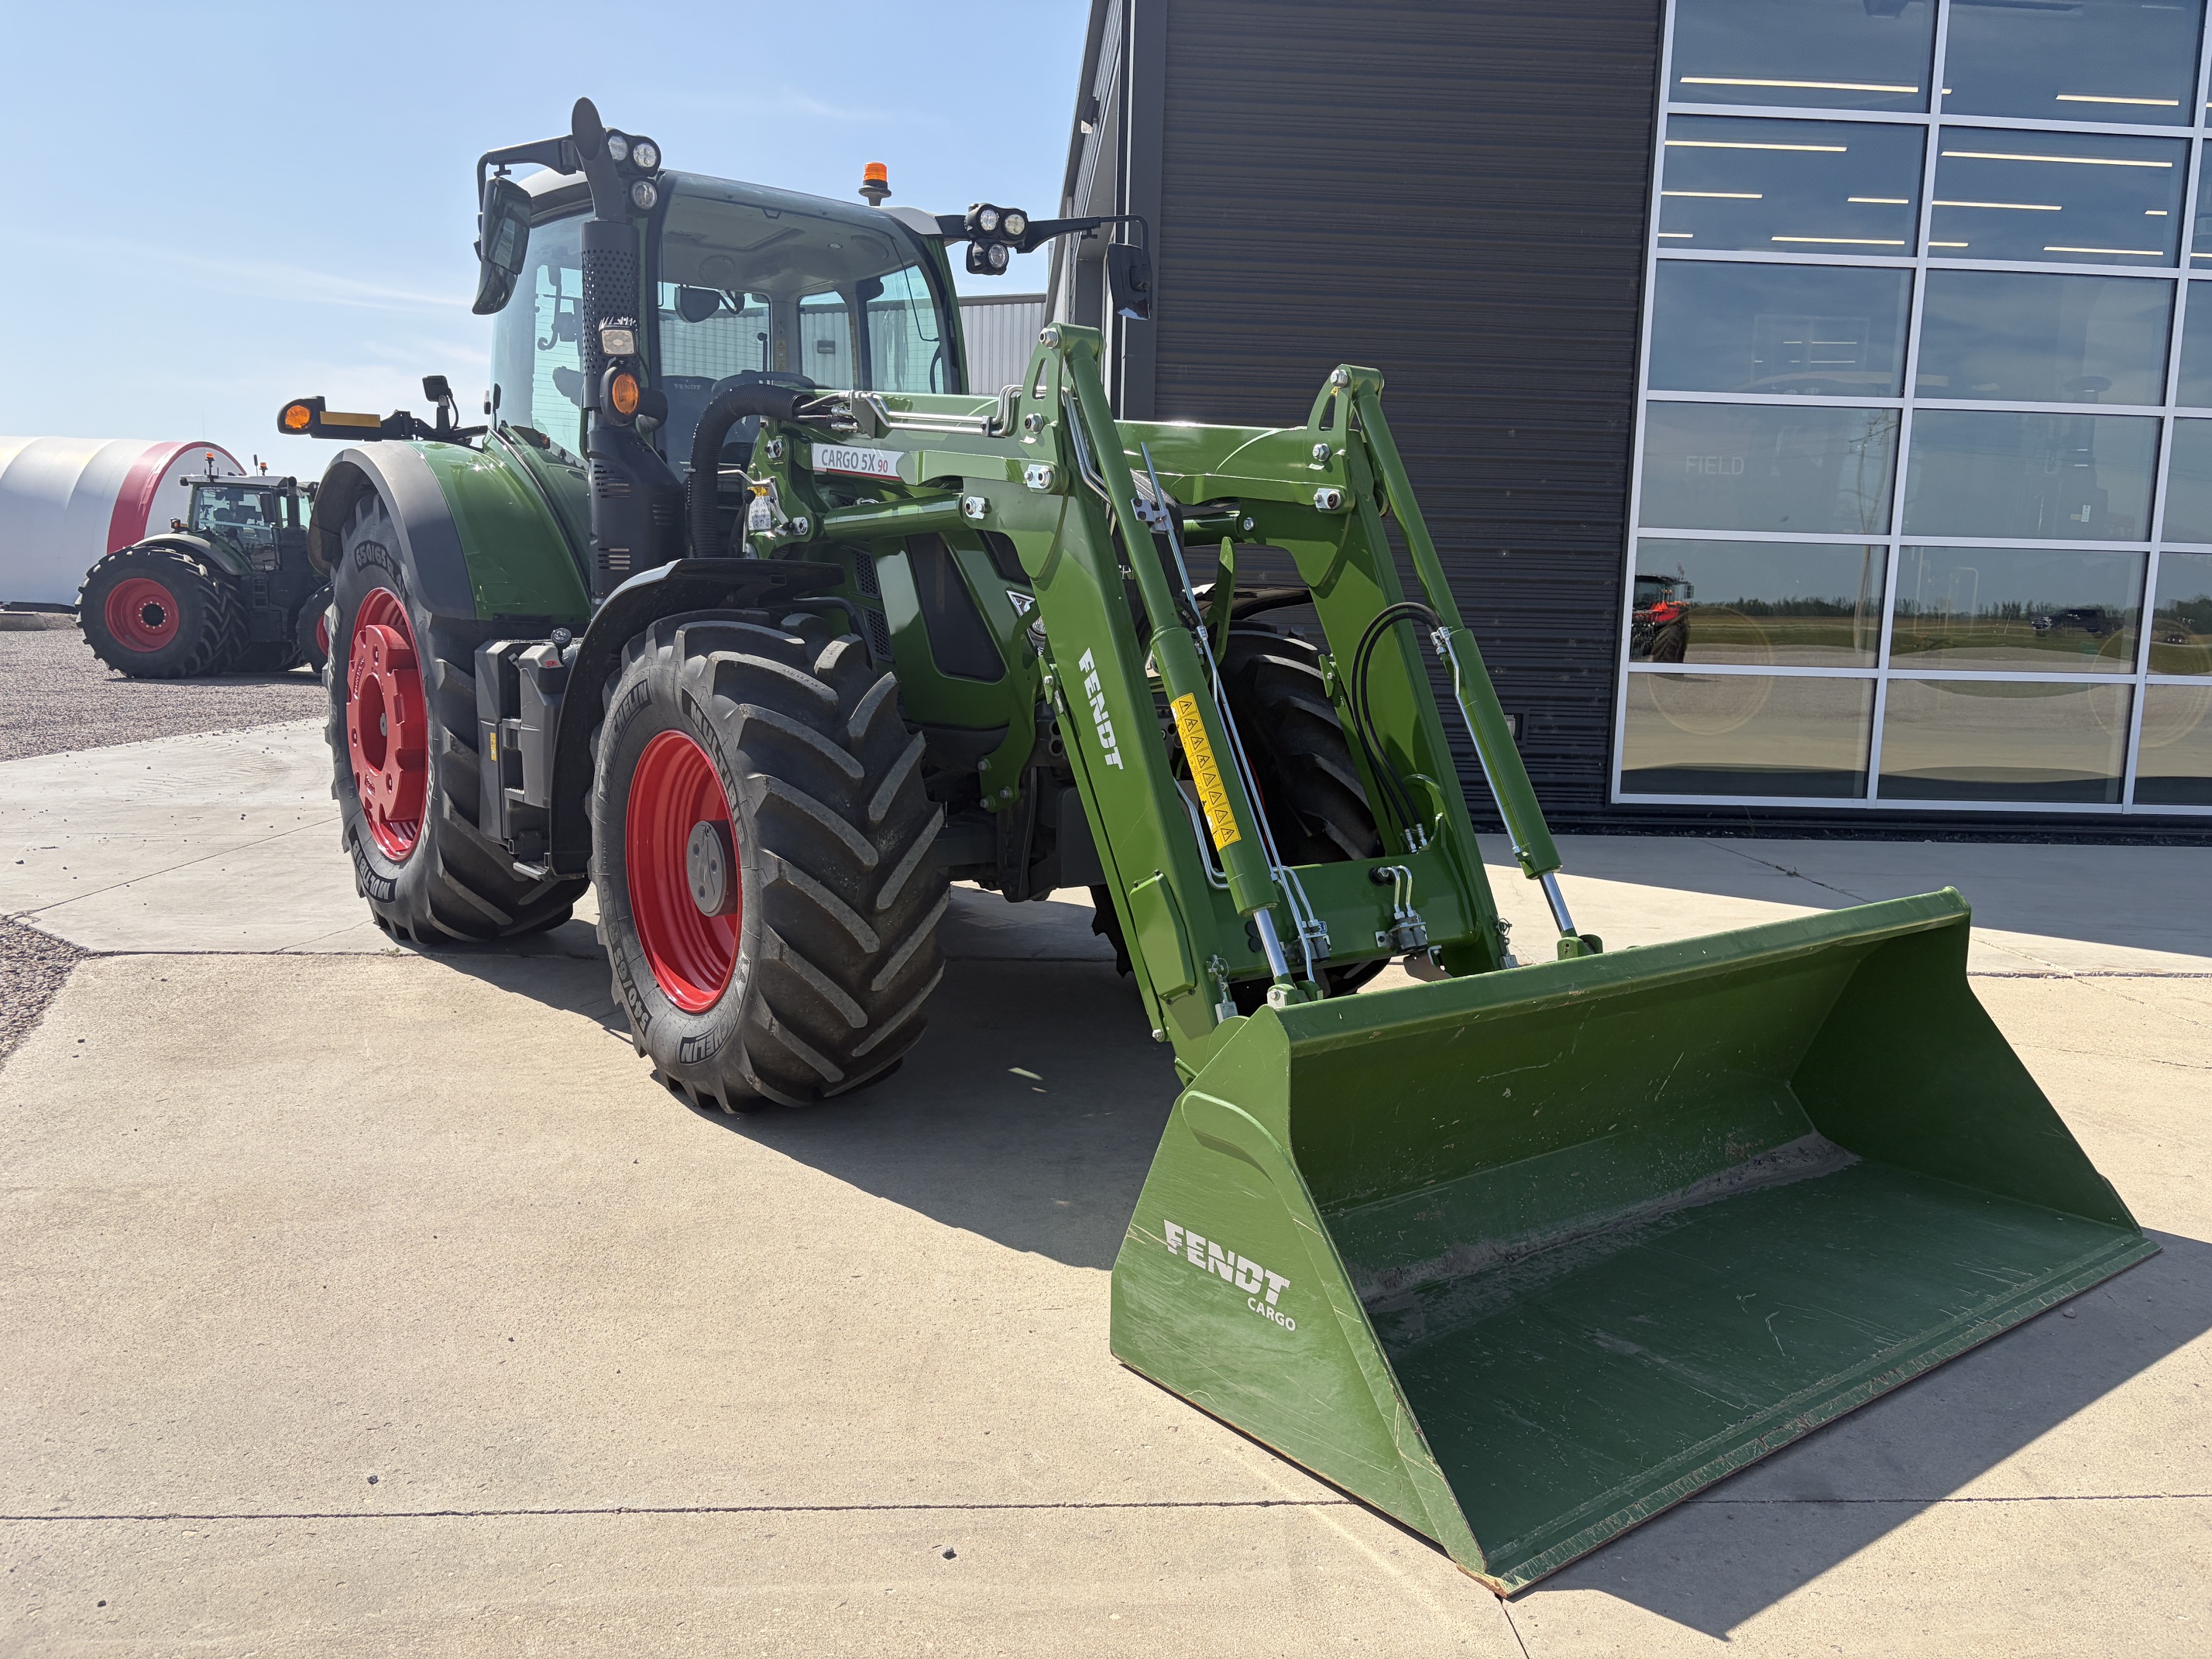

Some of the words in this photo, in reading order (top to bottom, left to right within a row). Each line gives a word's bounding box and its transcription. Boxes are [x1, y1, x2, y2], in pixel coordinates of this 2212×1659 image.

[821, 448, 859, 469] CARGO
[861, 453, 876, 472] 5X
[878, 459, 888, 473] 90
[1685, 455, 1744, 476] FIELD
[356, 543, 386, 568] 650/65
[1078, 647, 1124, 770] FENDT
[690, 700, 745, 845] MULTIBIB
[352, 840, 391, 900] MULTIBIB
[613, 946, 650, 1033] 540/65
[1163, 1219, 1291, 1306] FENDT
[1247, 1297, 1297, 1331] CARGO
